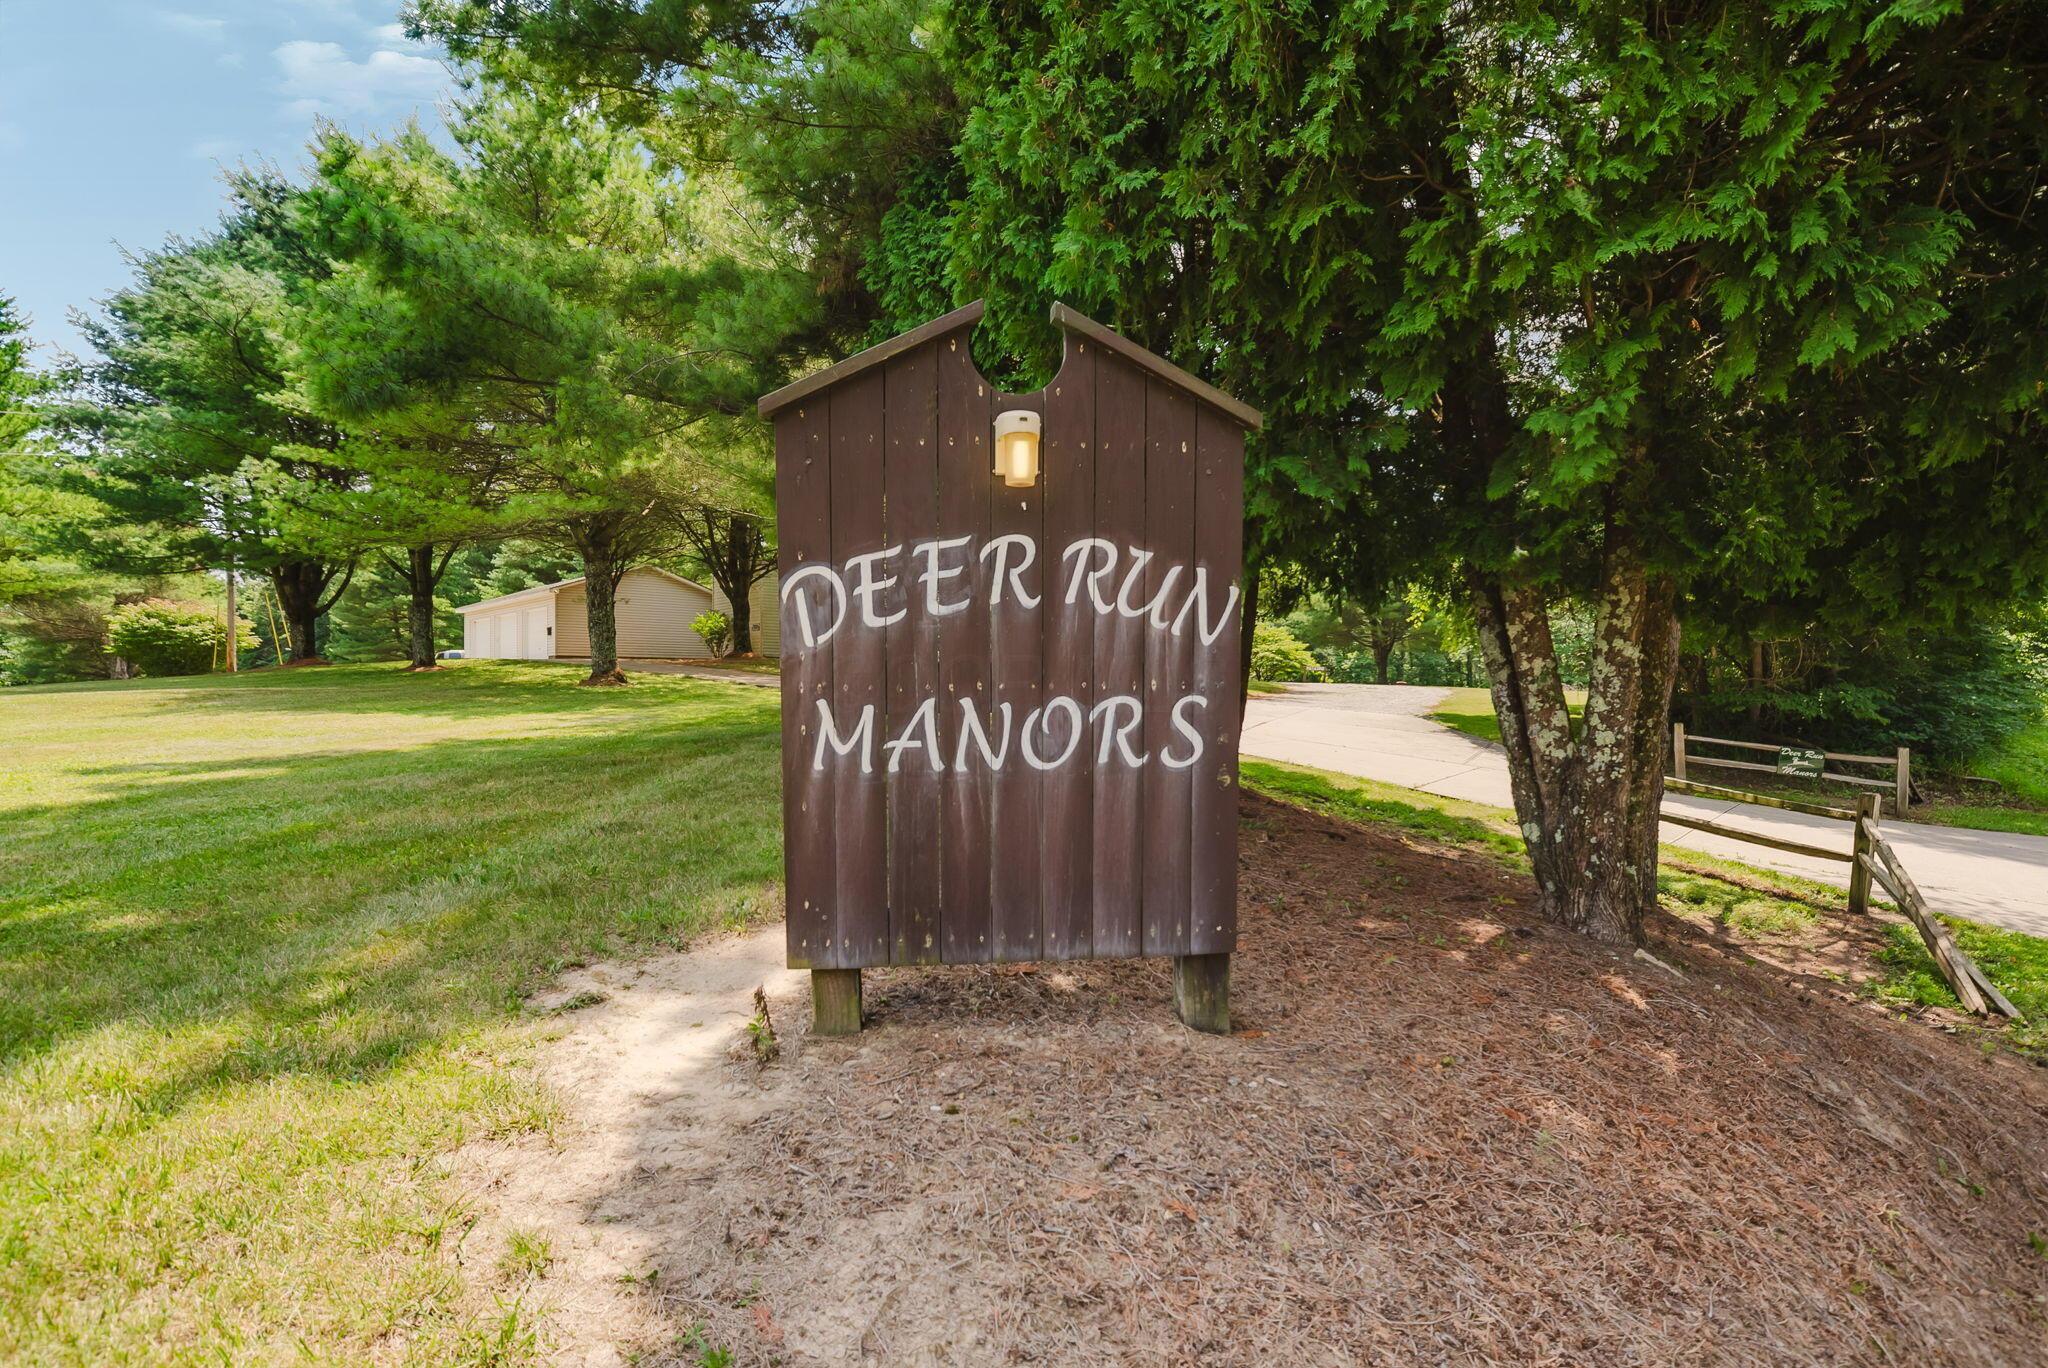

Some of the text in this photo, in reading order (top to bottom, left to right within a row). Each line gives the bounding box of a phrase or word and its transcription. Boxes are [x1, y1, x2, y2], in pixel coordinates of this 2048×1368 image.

[781, 534, 1240, 647] DEER RUN
[813, 695, 1208, 774] MANORS
[1781, 747, 1824, 760] Deer Run
[1781, 766, 1818, 778] Manors
